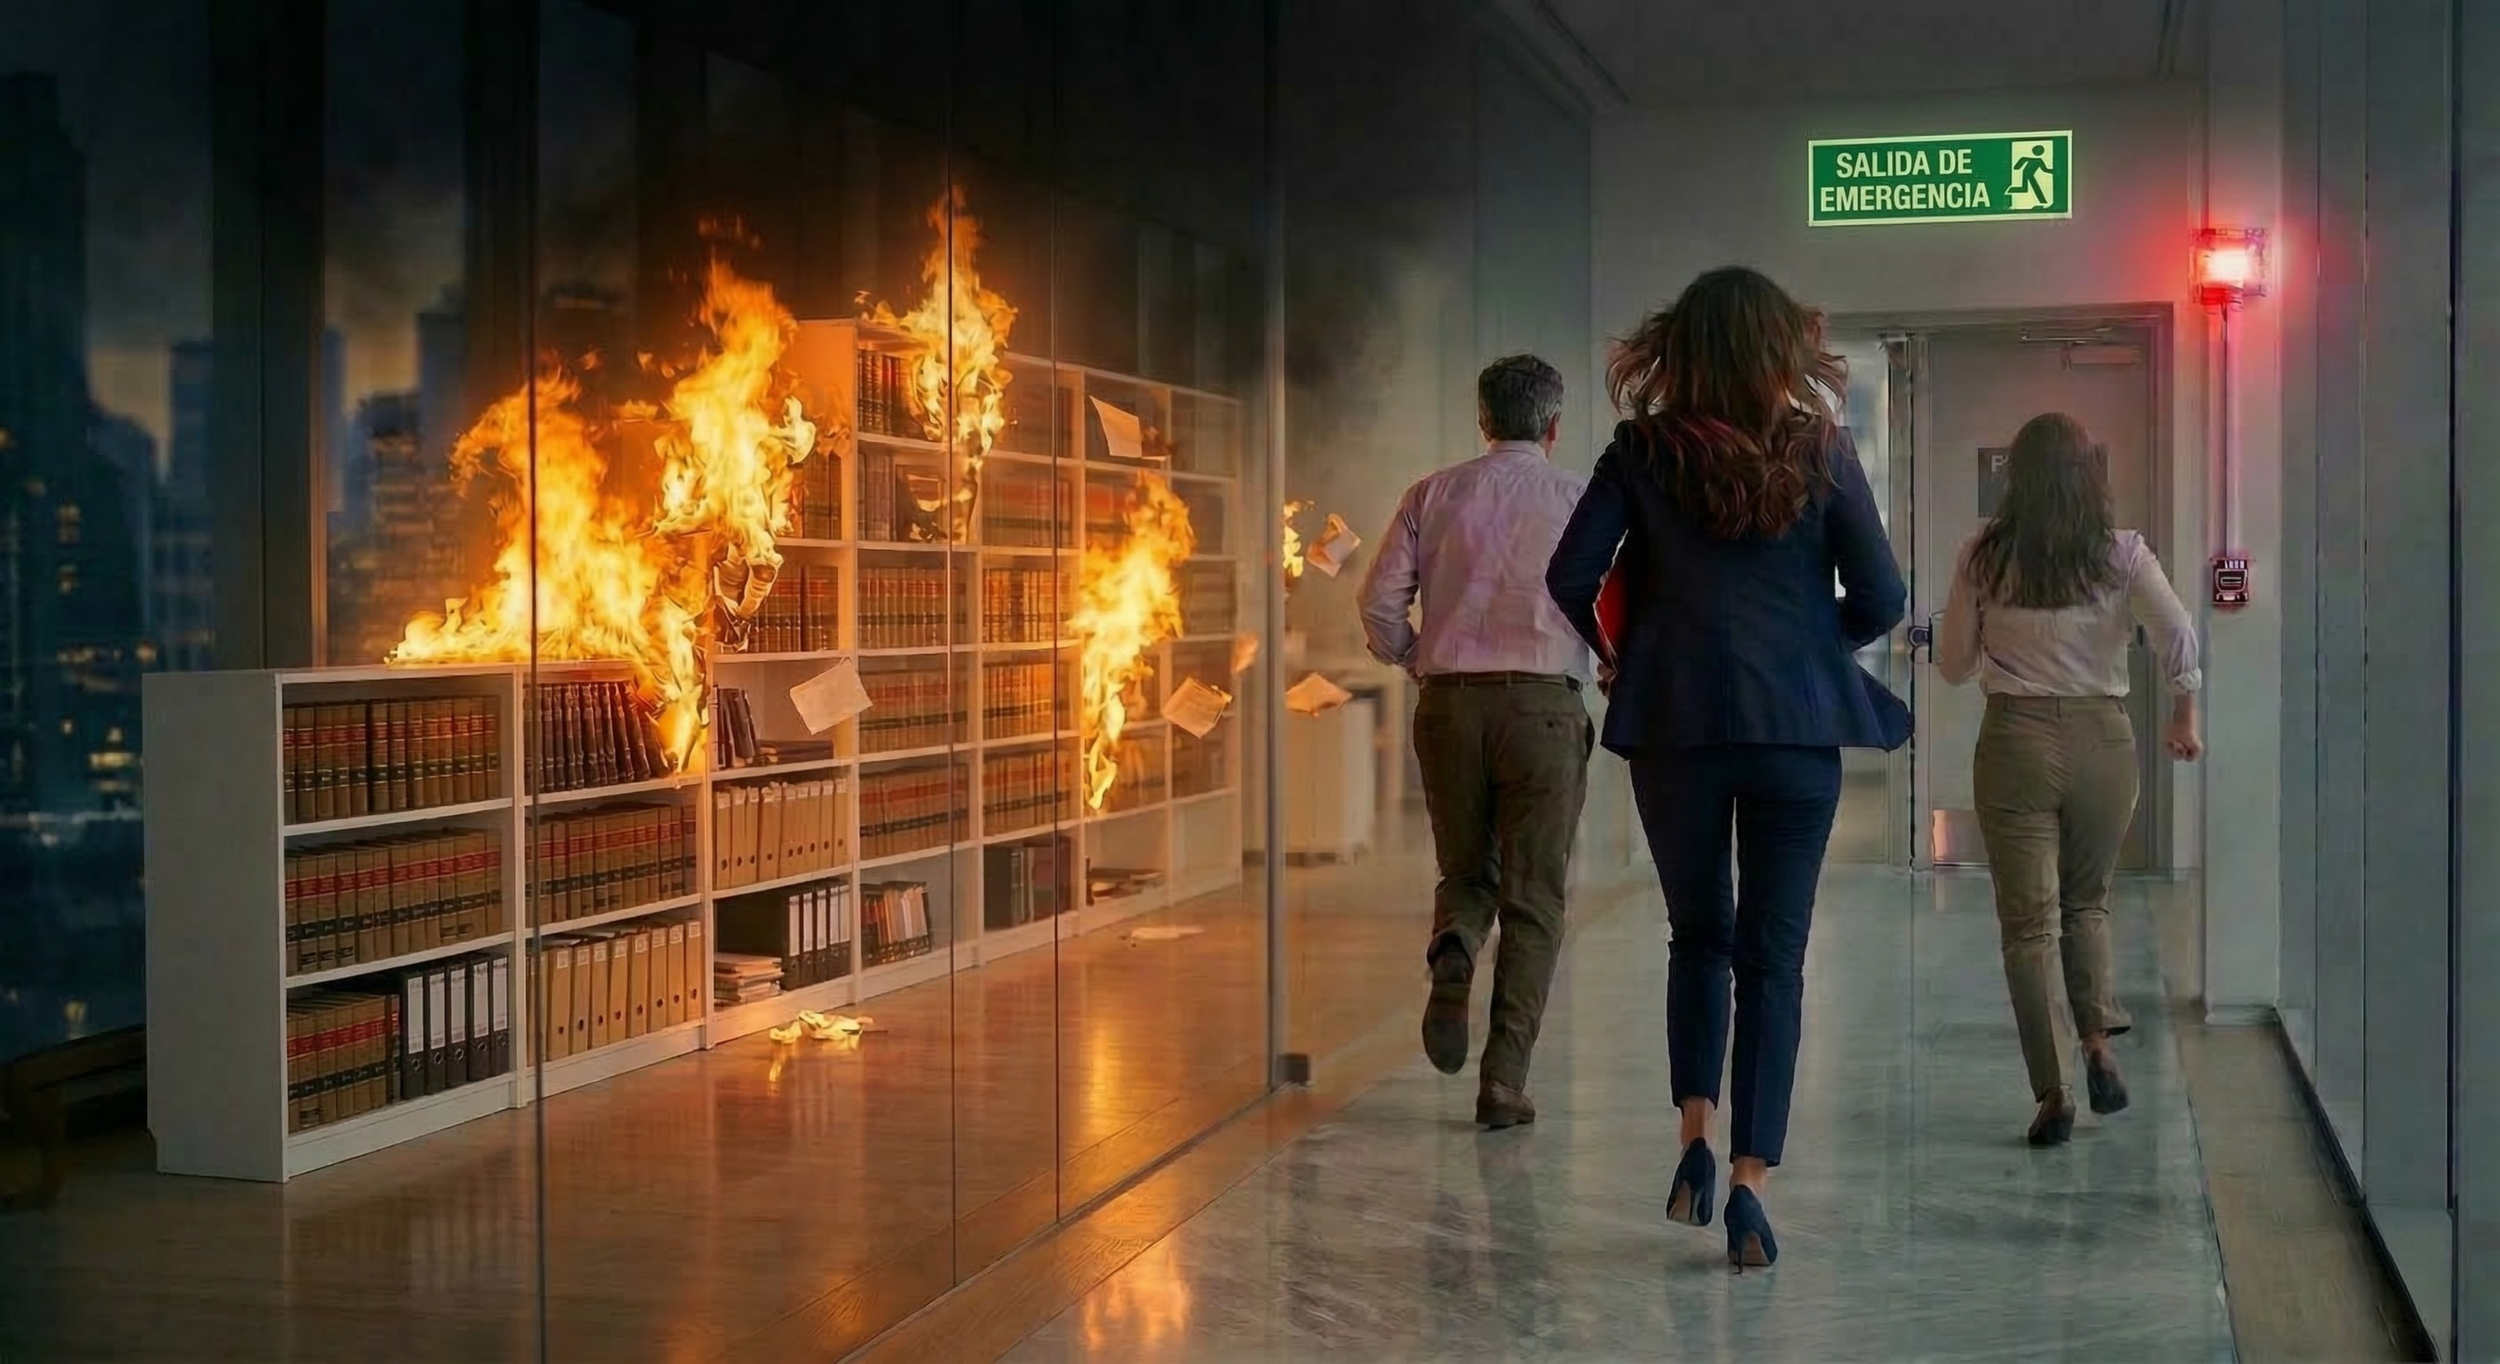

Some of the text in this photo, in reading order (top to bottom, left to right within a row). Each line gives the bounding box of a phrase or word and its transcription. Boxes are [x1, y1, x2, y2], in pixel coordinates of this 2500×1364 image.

[1836, 149, 1972, 178] SALIDA DE
[1820, 182, 1991, 212] EMERGENCIA
